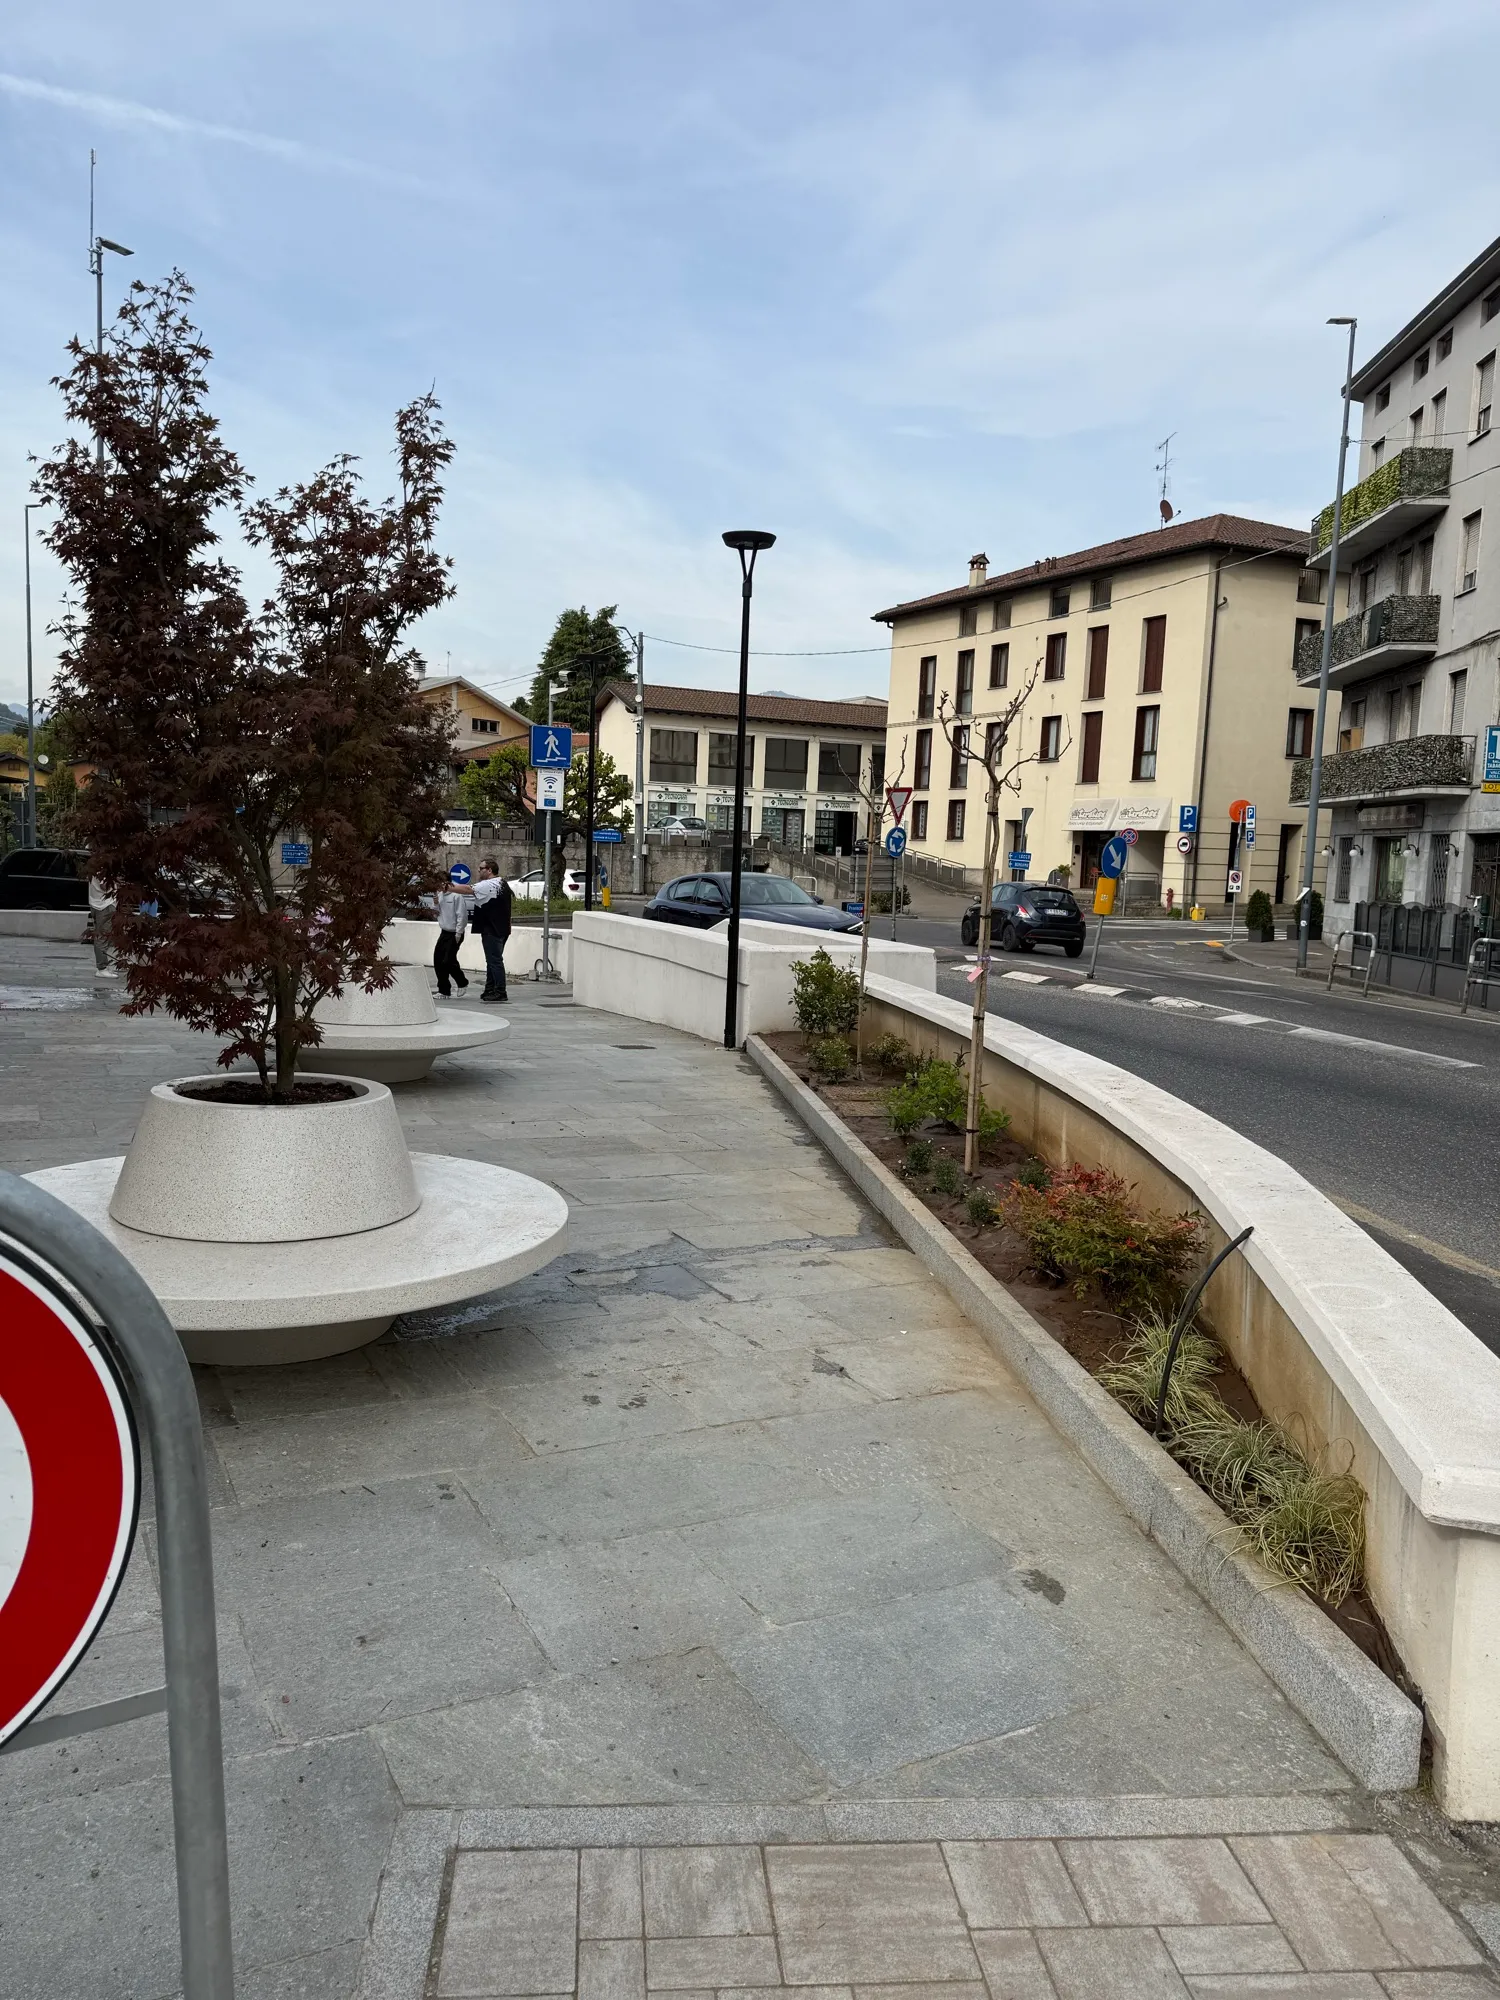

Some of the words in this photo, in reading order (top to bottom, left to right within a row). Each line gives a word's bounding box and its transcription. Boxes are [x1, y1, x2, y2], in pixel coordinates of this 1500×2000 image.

[1184, 807, 1193, 820] P
[1248, 808, 1253, 818] P
[1247, 833, 1253, 841] P
